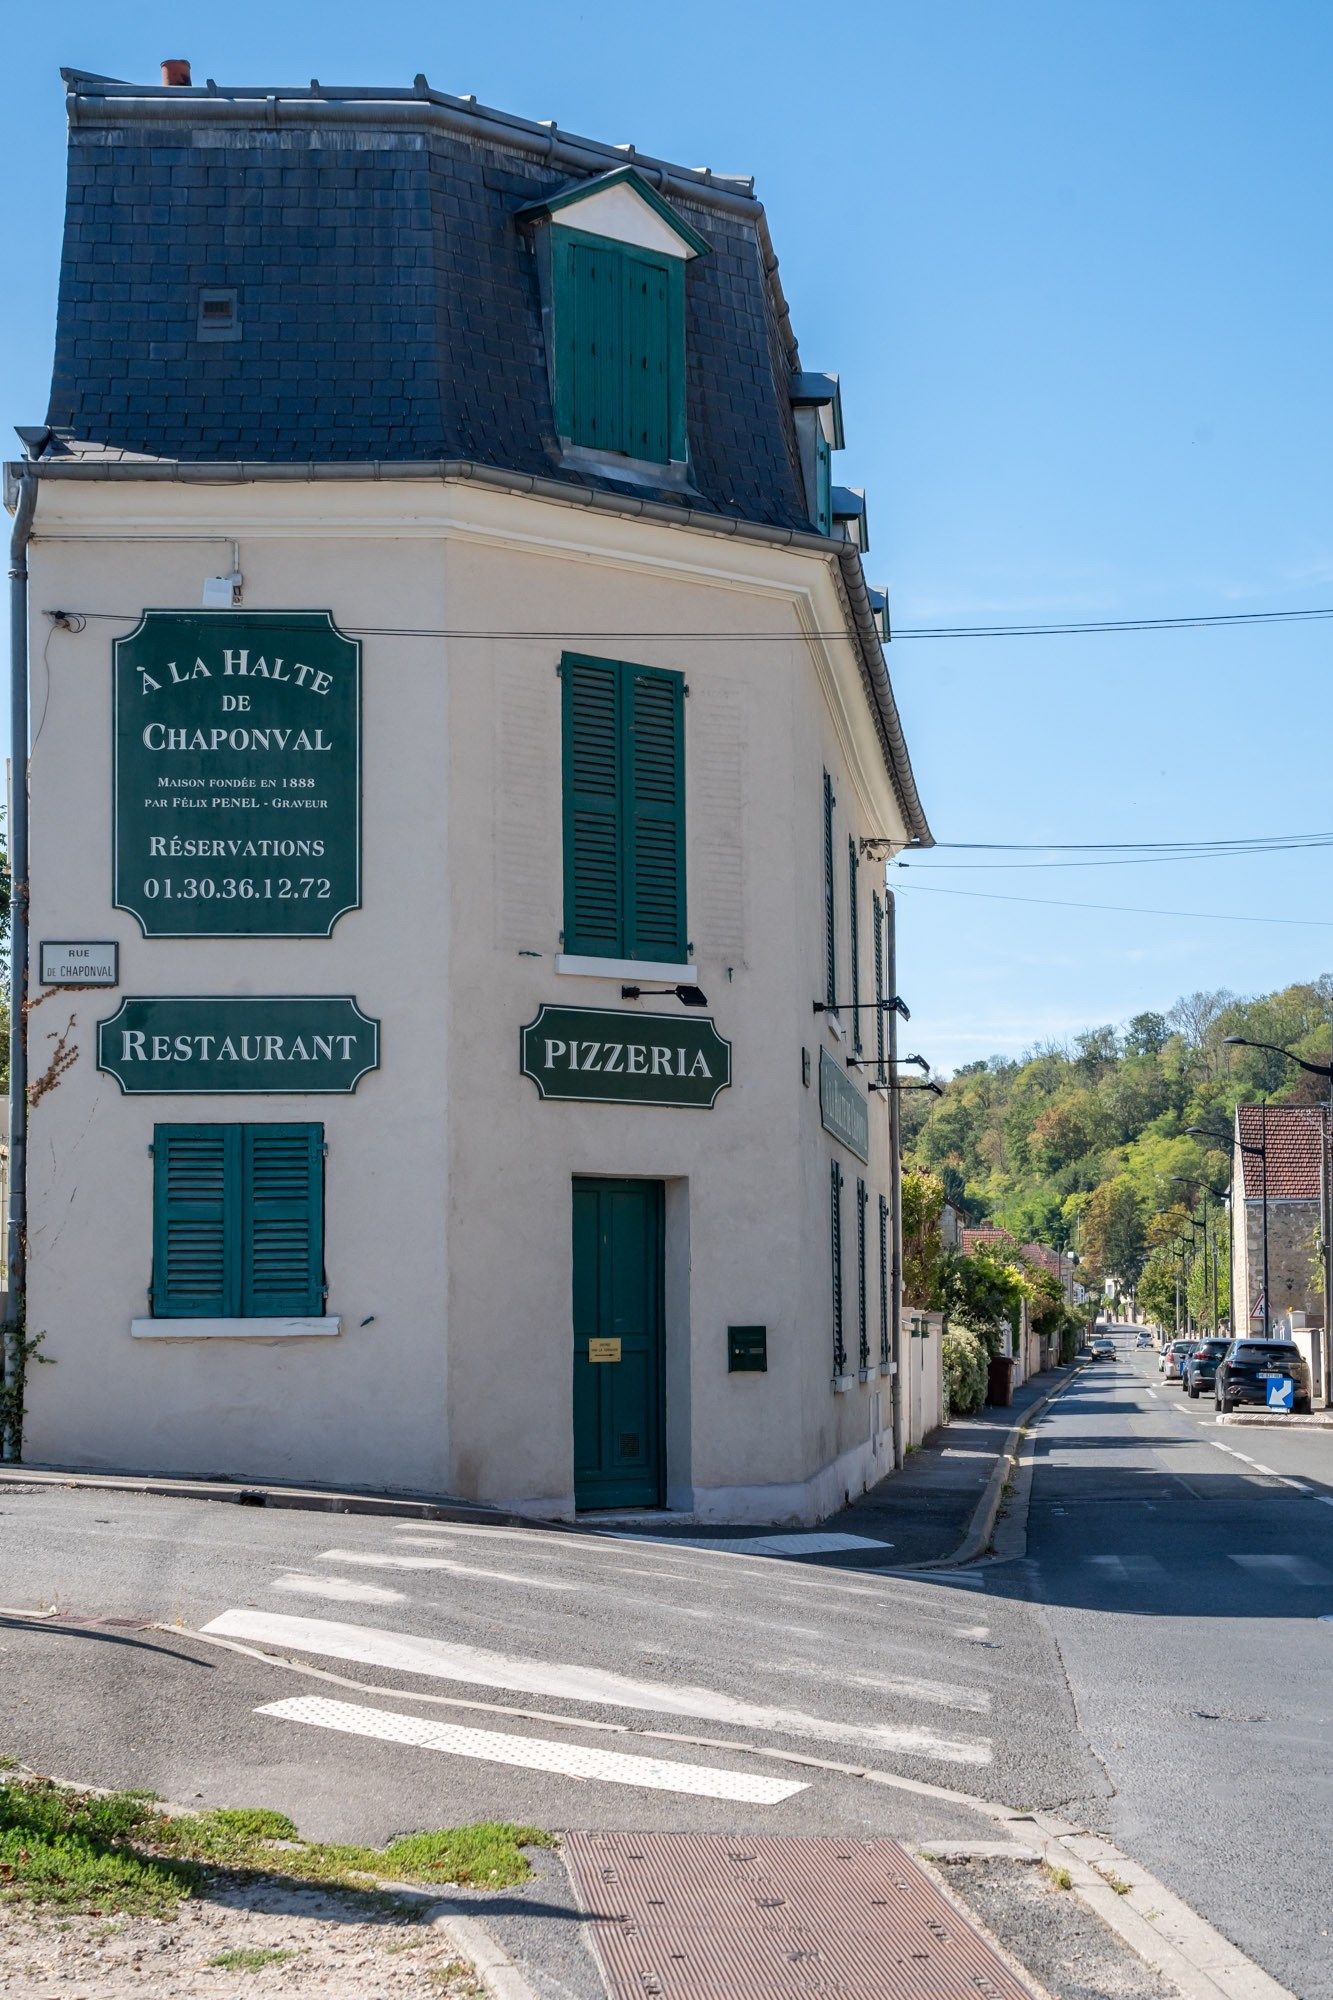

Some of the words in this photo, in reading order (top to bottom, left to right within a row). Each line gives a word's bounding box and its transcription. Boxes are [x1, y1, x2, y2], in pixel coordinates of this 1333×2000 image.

[136, 665, 162, 695] À
[167, 656, 213, 684] LA
[222, 649, 334, 696] HALTE
[221, 694, 251, 711] DE
[142, 723, 333, 751] CHAPONVAL
[157, 777, 205, 788] MAISON
[209, 776, 257, 788] FONDÉE
[260, 779, 277, 788] EN
[282, 778, 316, 788] 1888
[144, 799, 168, 808] PAR
[172, 796, 208, 808] FÉLIX
[211, 797, 260, 808] PENEL
[271, 797, 328, 808] GRAVEUR
[149, 835, 325, 857] RÉSERVATIONS
[143, 878, 331, 899] 01.30.36.12.72
[68, 949, 90, 958] RUE
[46, 967, 57, 977] DE
[60, 965, 113, 977] CHAPONVAL
[120, 1030, 358, 1062] RESTAURANT
[543, 1038, 713, 1078] PIZZERIA
